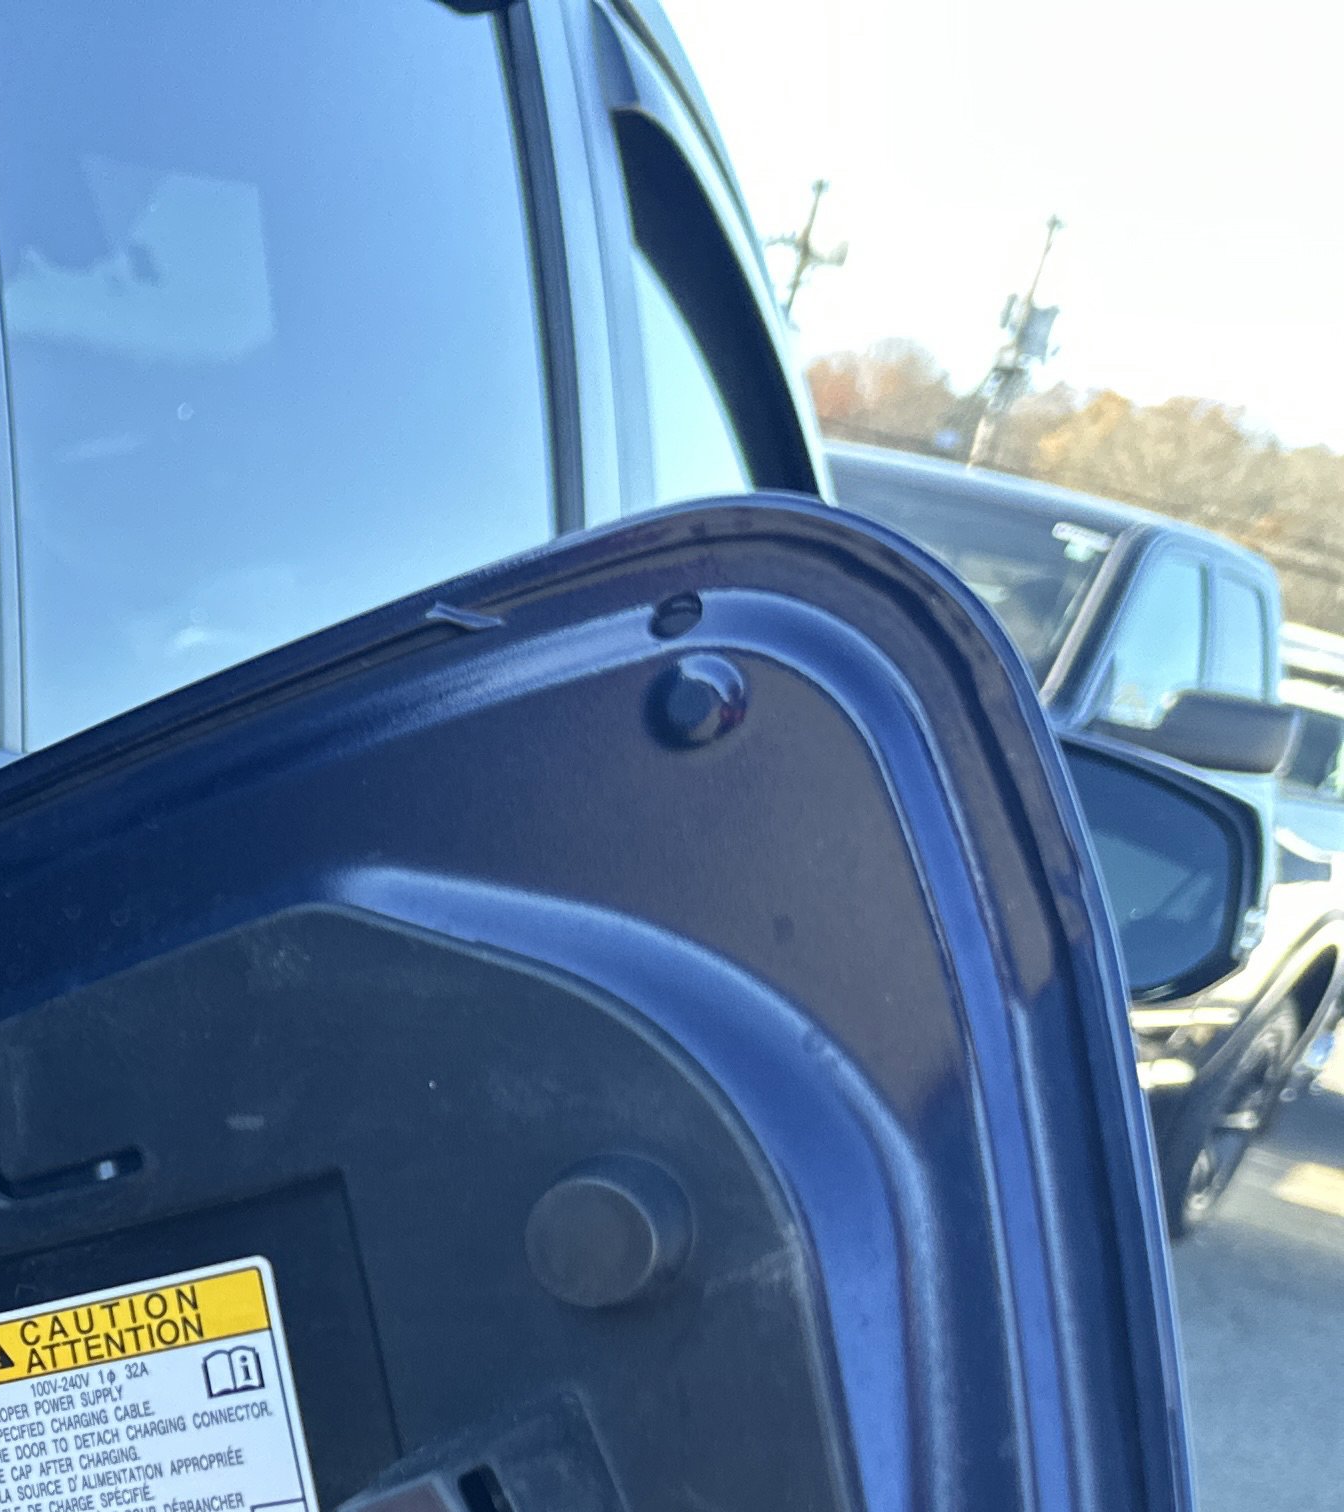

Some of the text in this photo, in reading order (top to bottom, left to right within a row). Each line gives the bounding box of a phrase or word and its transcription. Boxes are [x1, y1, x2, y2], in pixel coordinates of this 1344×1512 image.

[20, 1285, 199, 1346] CAUTION
[26, 1313, 204, 1373] ATTENTION
[30, 1372, 89, 1398] 100V-240V
[125, 1361, 149, 1379] 32A
[34, 1394, 75, 1416] POWER
[80, 1384, 123, 1407] SUPPLY
[50, 1409, 109, 1433] CHARGING
[114, 1400, 155, 1422] CABLE.
[15, 1441, 47, 1460] DOOR
[52, 1437, 68, 1453] TO
[74, 1428, 120, 1450] DETACH
[126, 1415, 186, 1440] CHARGING
[192, 1401, 272, 1429] CONNECTOR.
[10, 1464, 32, 1481] CAP
[39, 1457, 73, 1477] AFTER
[79, 1445, 141, 1470] CHARGING.
[17, 1479, 63, 1501] SOURCE
[170, 1445, 244, 1476] APPROPRIÉE
[99, 1482, 155, 1508] SPÉCIFIÉ.
